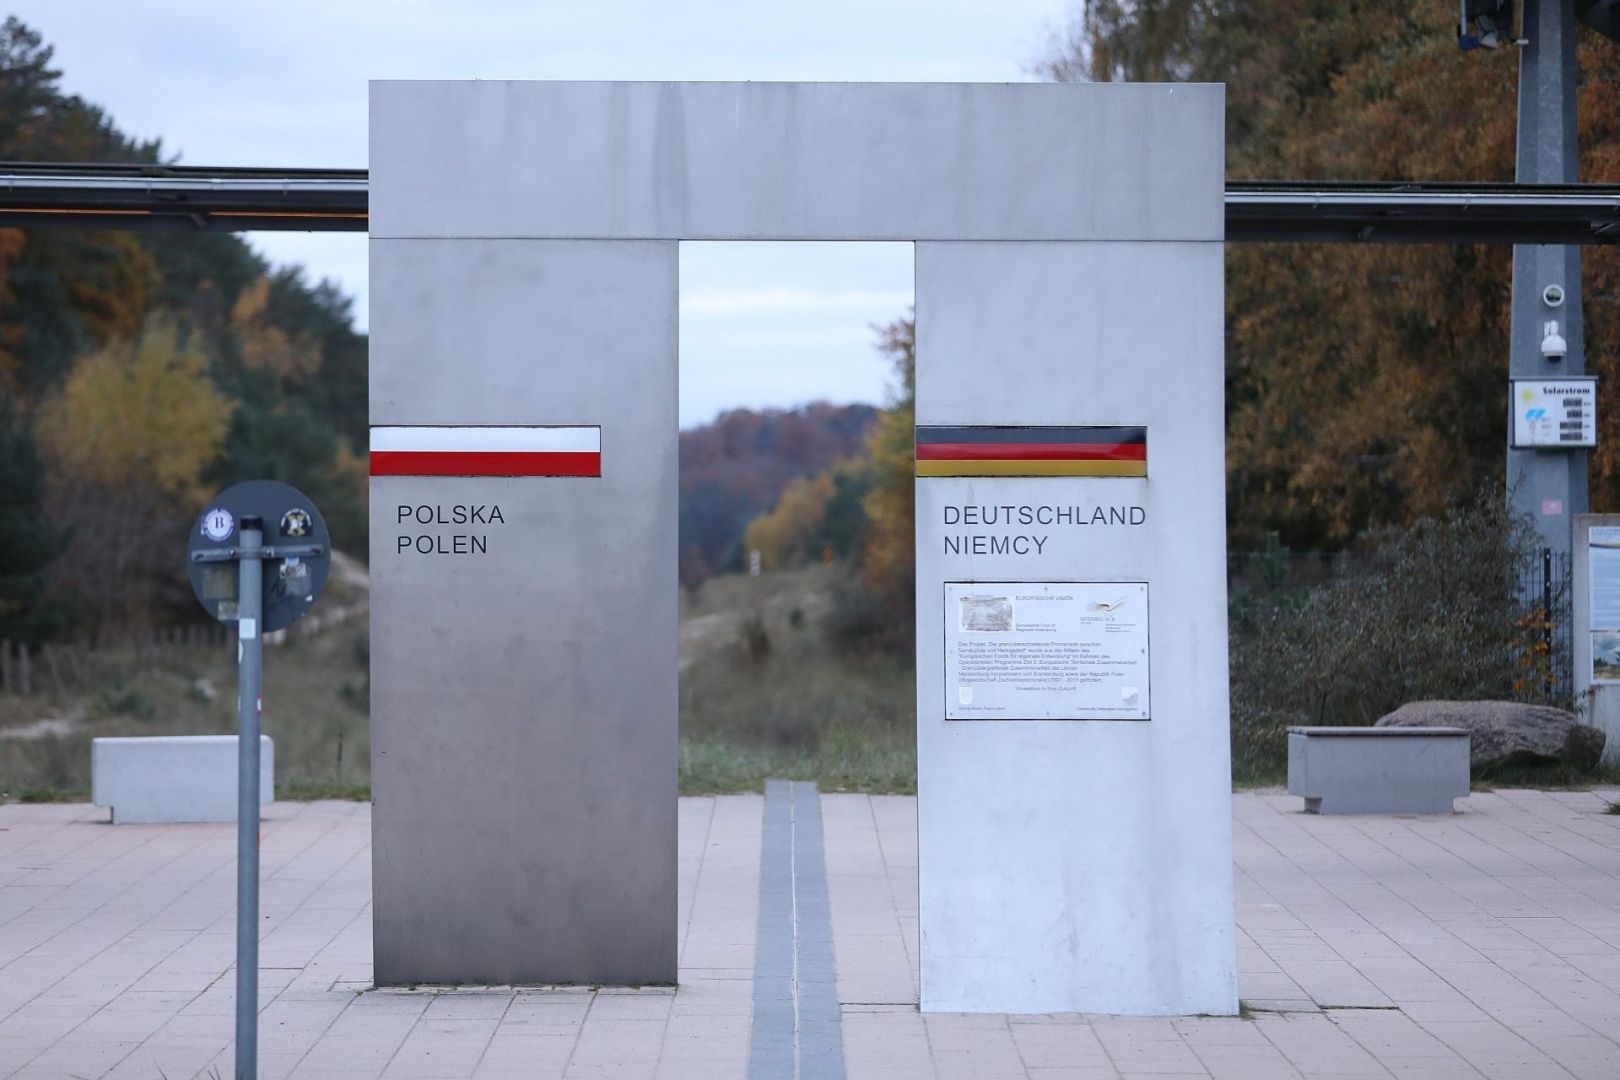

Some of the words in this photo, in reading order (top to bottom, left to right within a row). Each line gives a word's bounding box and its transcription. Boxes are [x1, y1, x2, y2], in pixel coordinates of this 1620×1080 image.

[1543, 387, 1590, 395] Solarstrom
[398, 505, 505, 524] POLSKA
[944, 506, 1146, 525] DEUTSCHLAND
[398, 535, 487, 554] POLEN
[944, 536, 1048, 555] NIEMCY
